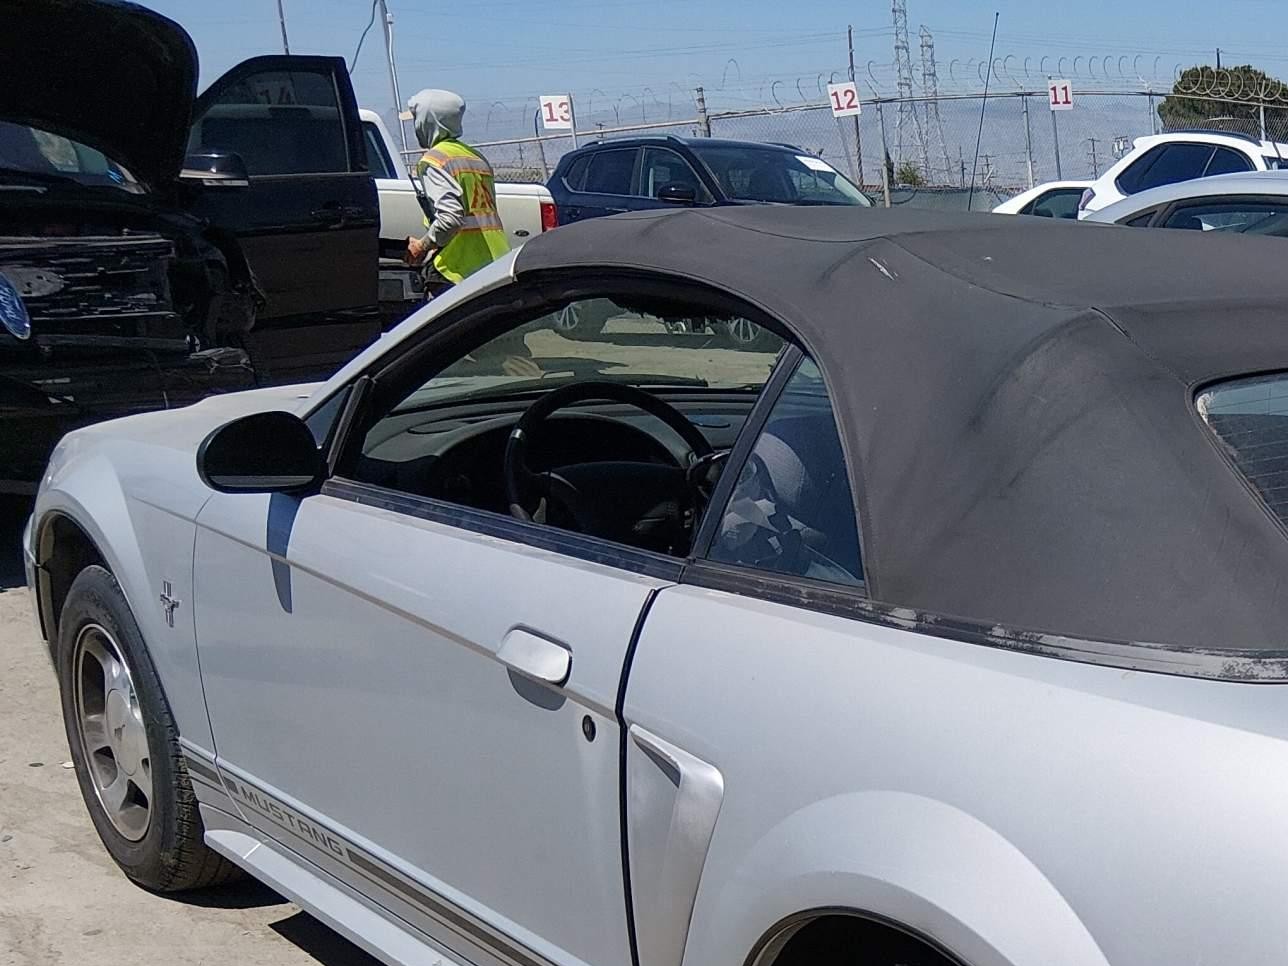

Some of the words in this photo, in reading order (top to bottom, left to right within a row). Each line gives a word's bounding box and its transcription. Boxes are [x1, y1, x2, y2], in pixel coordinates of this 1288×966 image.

[831, 88, 858, 112] 12
[1050, 84, 1072, 105] 11
[543, 101, 571, 122] 13
[240, 785, 344, 856] MUSTANG
